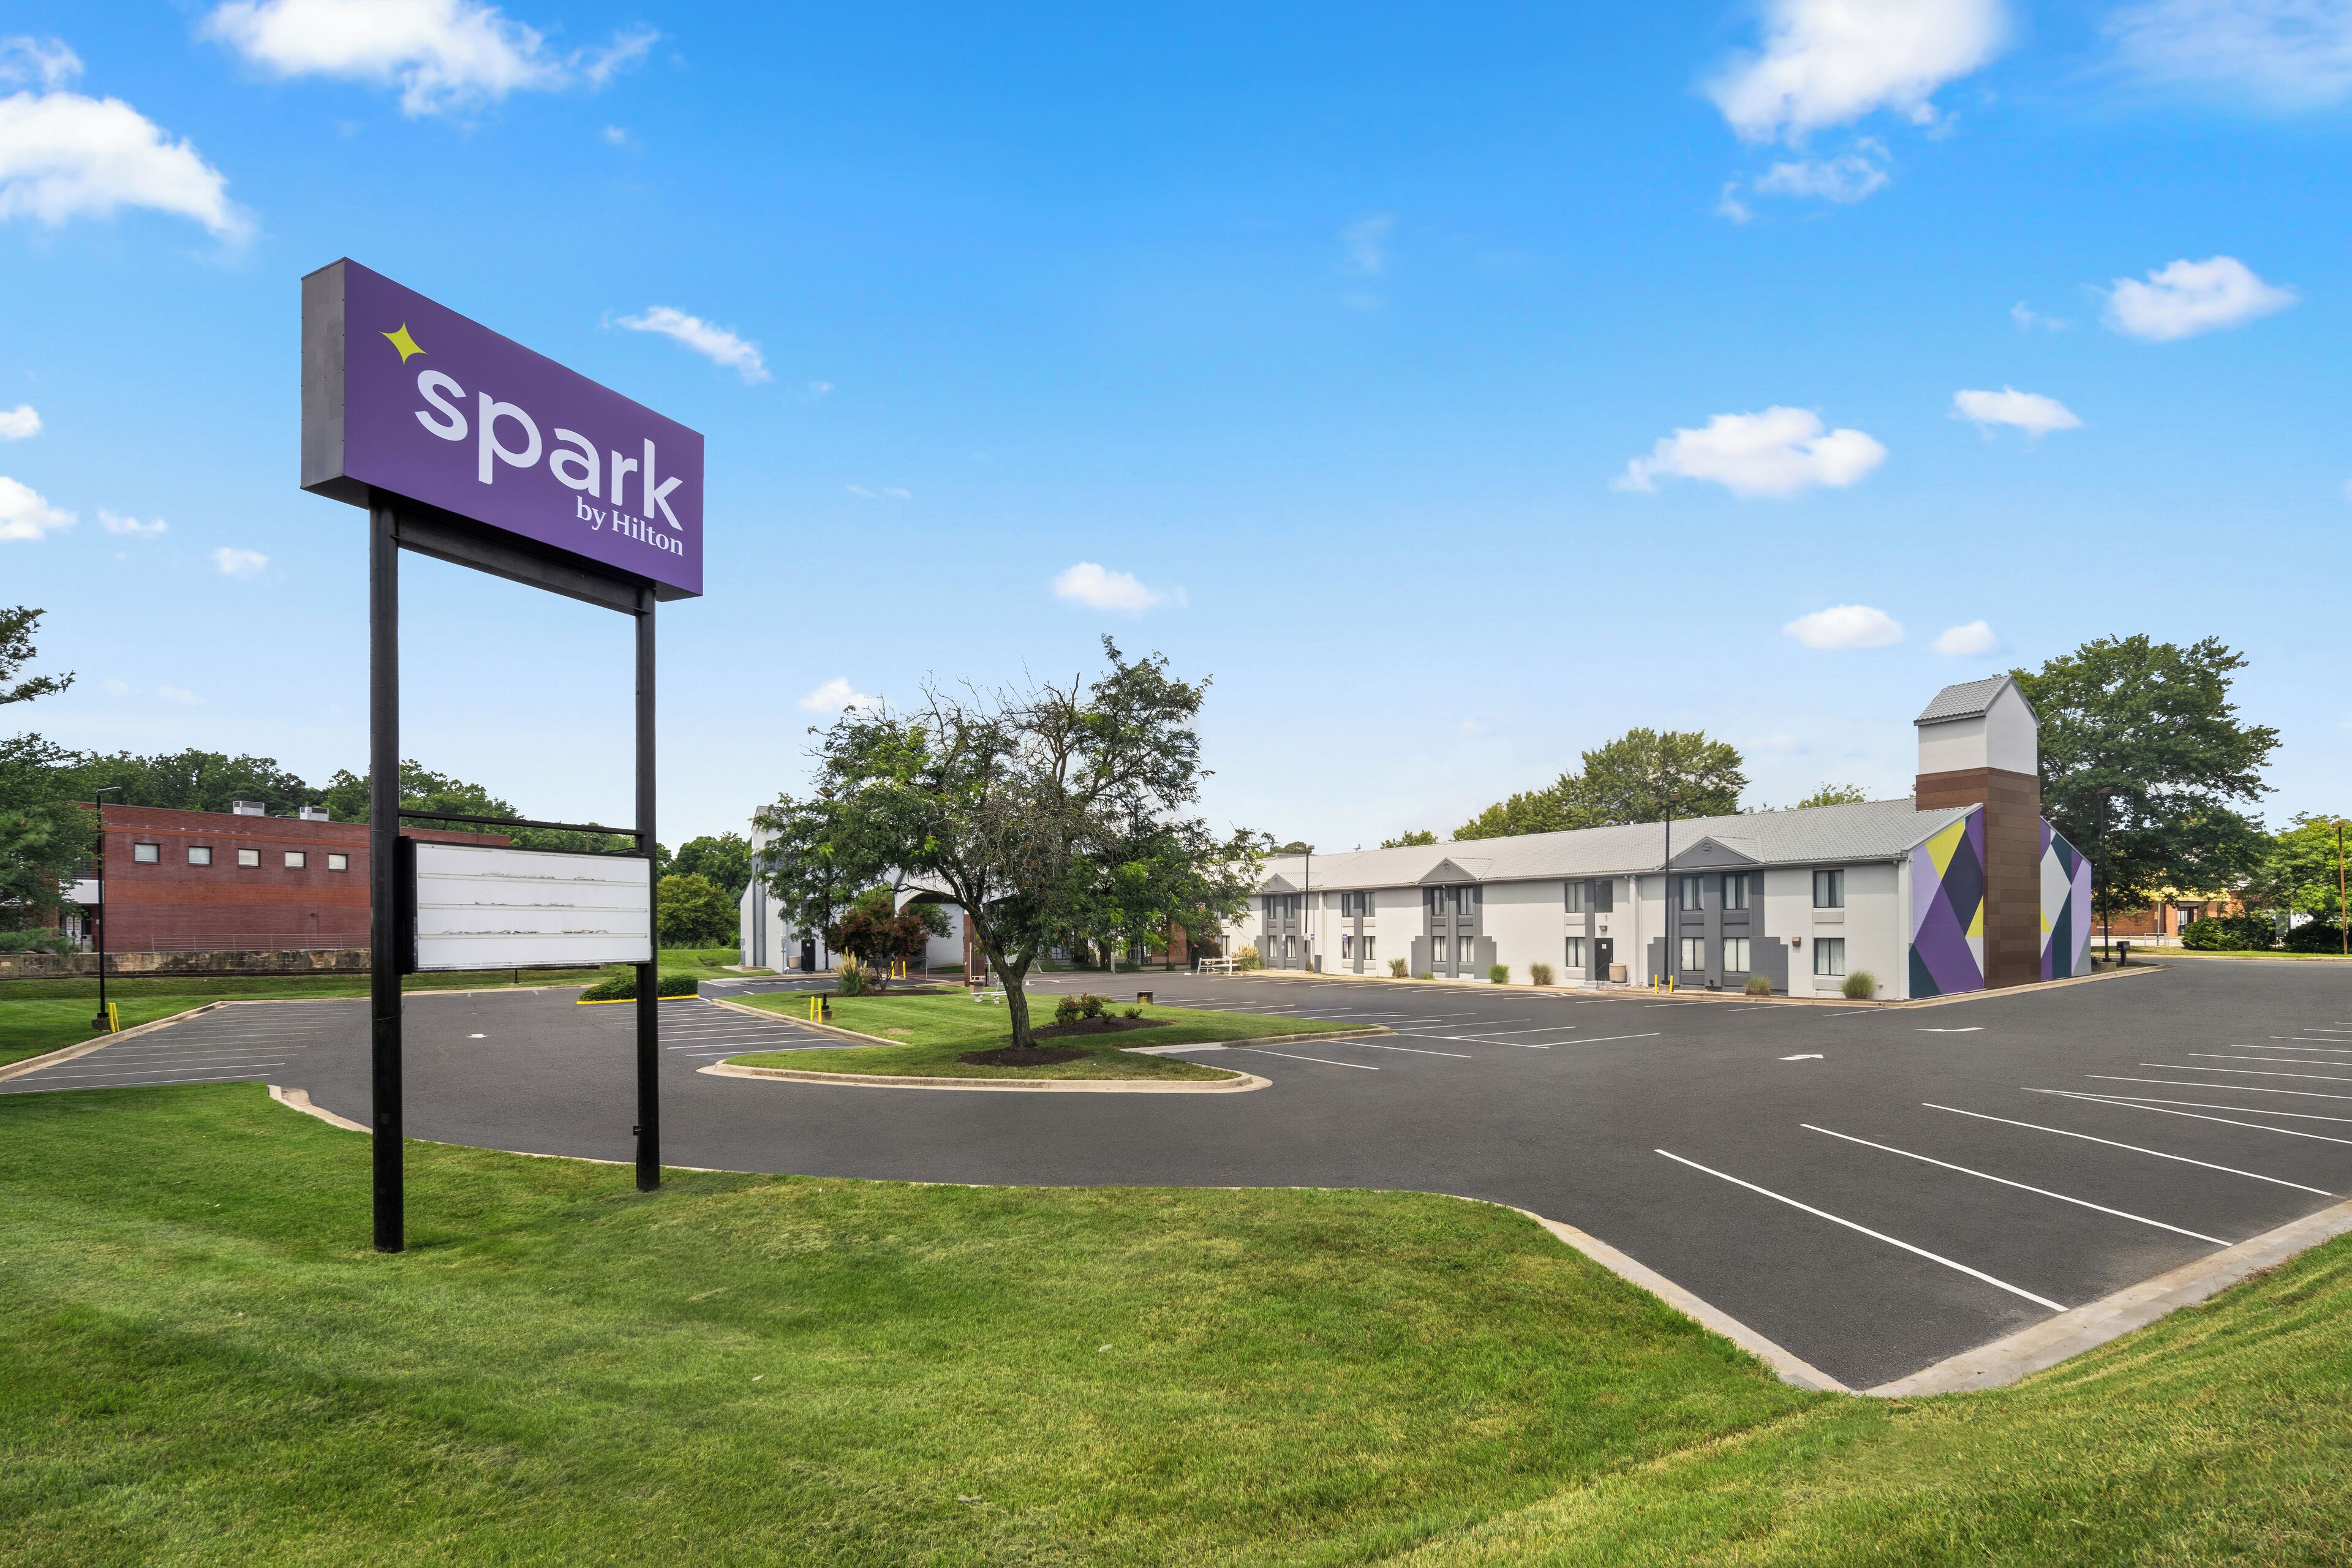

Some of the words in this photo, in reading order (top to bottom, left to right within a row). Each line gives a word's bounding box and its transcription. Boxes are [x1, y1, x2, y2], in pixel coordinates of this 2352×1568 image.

[414, 369, 684, 532] spark
[576, 495, 607, 531] by
[611, 510, 684, 556] Hilton
